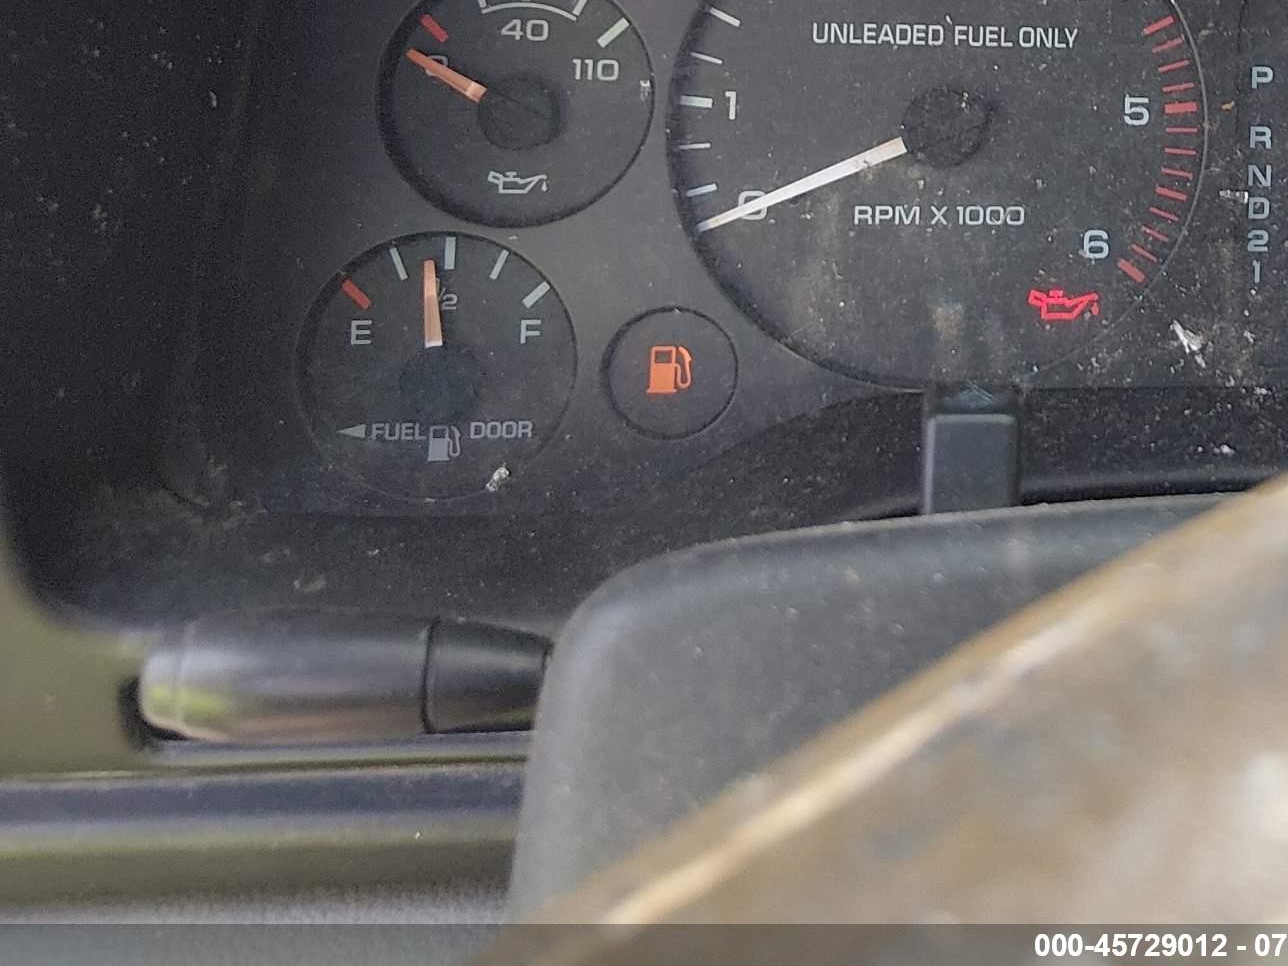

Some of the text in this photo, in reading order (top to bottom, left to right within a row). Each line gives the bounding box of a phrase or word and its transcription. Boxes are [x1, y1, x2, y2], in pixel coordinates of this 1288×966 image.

[500, 19, 549, 41] 40
[812, 23, 1078, 49] UNLEADED FUEL ONLY
[572, 58, 619, 81] 110
[1251, 66, 1274, 89] P
[724, 91, 737, 119] 1
[1123, 96, 1150, 125] 5
[1250, 126, 1272, 149] R
[1248, 164, 1272, 187] N
[853, 205, 1025, 227] RPM X 1000
[1248, 197, 1270, 220] D
[1082, 229, 1109, 259] 6
[1247, 230, 1269, 252] 2
[1252, 260, 1261, 282] 1
[351, 320, 372, 344] E
[520, 320, 541, 344] F
[372, 421, 533, 441] FUEL DOOR
